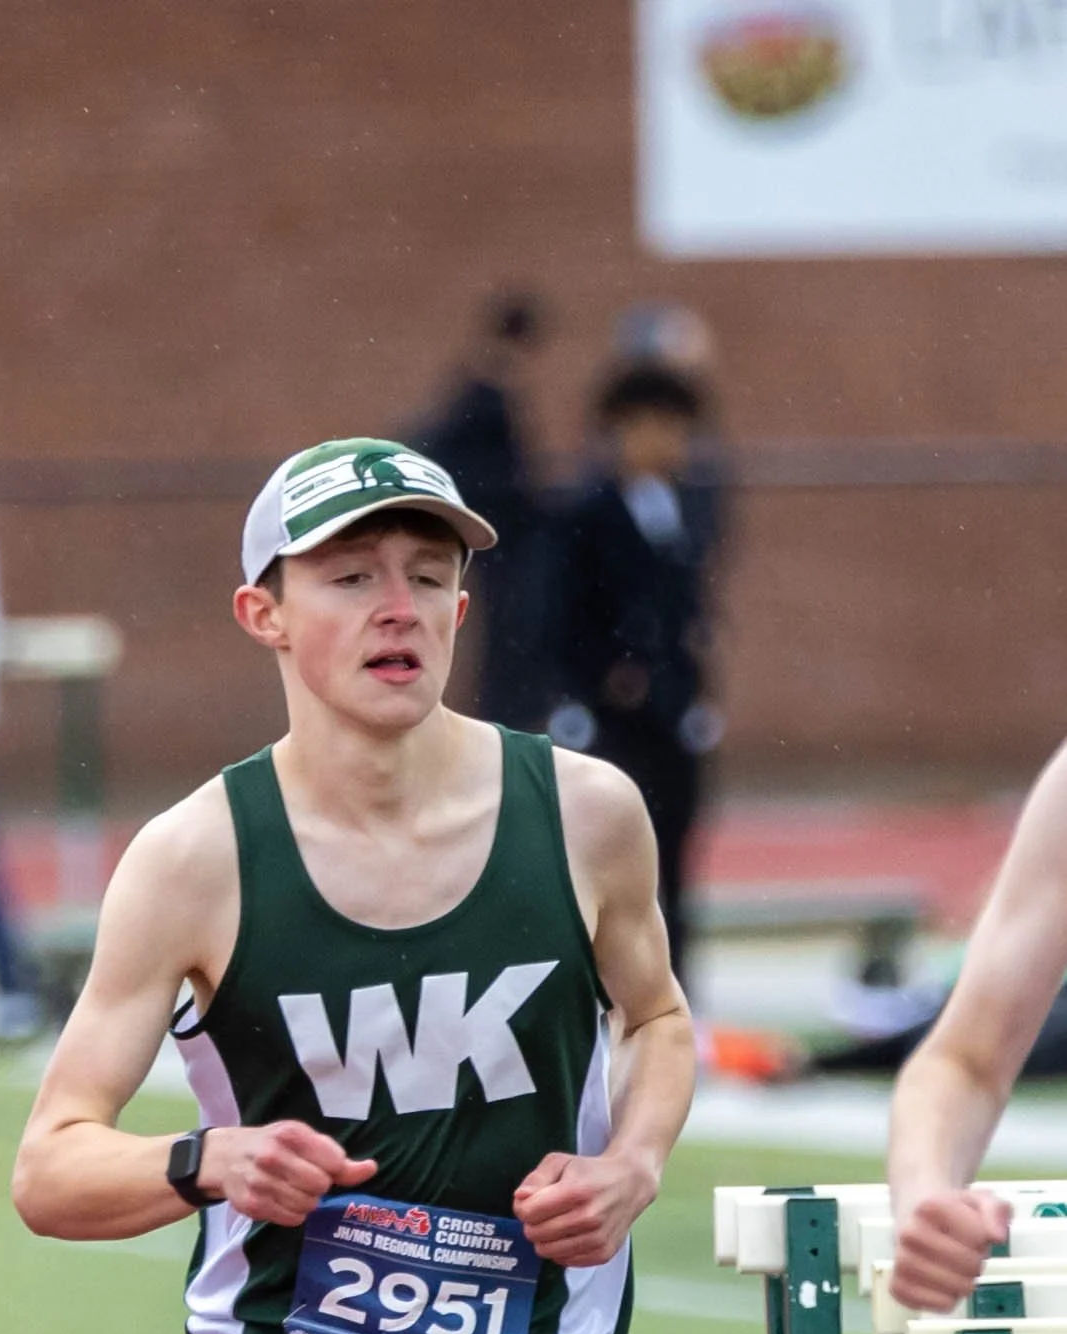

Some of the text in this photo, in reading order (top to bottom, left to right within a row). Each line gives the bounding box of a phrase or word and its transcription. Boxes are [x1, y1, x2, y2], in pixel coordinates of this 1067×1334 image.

[278, 960, 560, 1121] WK
[435, 1231, 514, 1252] COUNTRY
[438, 1216, 496, 1236] CROSS
[333, 1226, 519, 1271] JH/MS REGIONAL CHAMPIONSHIP
